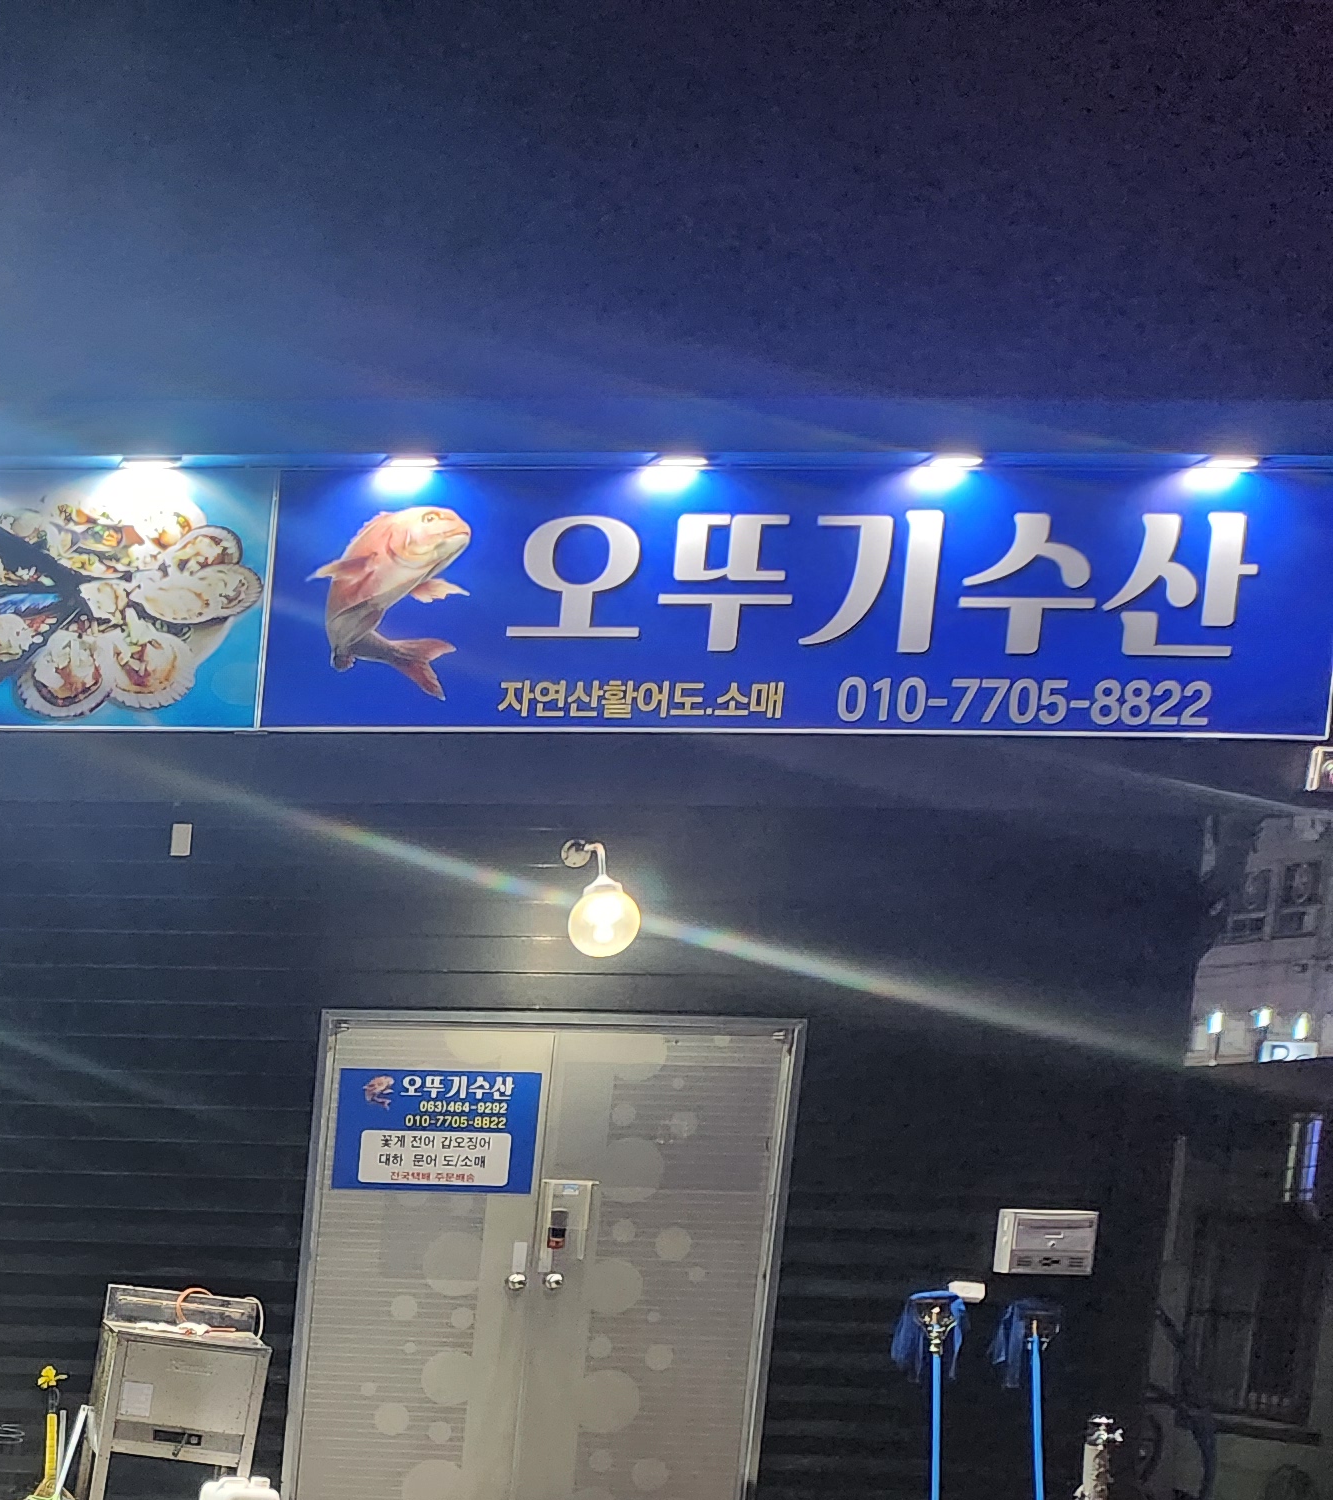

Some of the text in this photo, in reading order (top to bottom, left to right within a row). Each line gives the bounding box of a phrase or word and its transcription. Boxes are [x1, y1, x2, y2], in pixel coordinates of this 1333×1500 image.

[505, 508, 1259, 659] 오뚜기수산
[497, 675, 1212, 727] 자연산활어도.소매 010-7705-8822
[400, 1076, 514, 1100] 오뚜기수산
[419, 1101, 508, 1114] 063)464-9292
[405, 1115, 507, 1128] 010-7705-8822
[380, 1135, 491, 1150] 꽃게 전어 갑오징어
[379, 1153, 486, 1168] 대하 문어 도/소매
